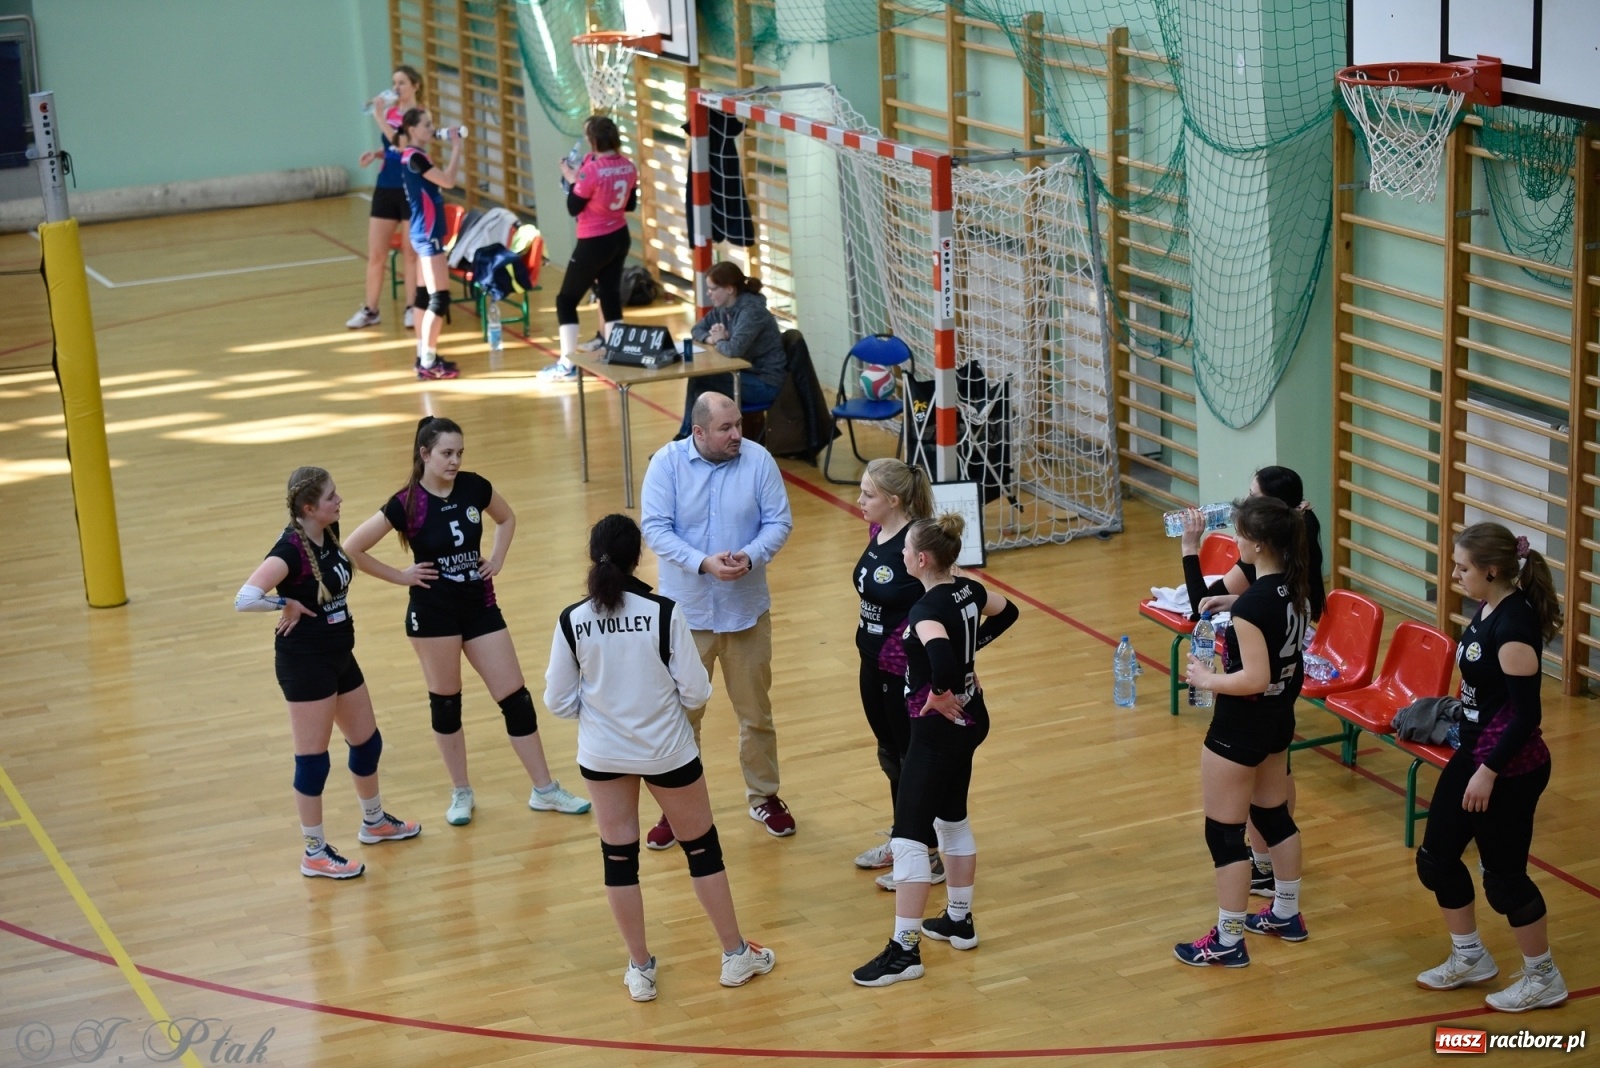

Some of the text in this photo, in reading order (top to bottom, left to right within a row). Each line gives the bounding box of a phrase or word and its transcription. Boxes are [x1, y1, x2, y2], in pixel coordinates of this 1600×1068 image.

[609, 180, 628, 211] 3
[610, 327, 664, 350] 18 0 0 14
[449, 520, 464, 547] 5
[333, 562, 351, 590] 16
[858, 567, 868, 593] 3
[411, 612, 419, 631] 5
[576, 616, 652, 640] PV VOLLEY
[960, 601, 979, 665] 17
